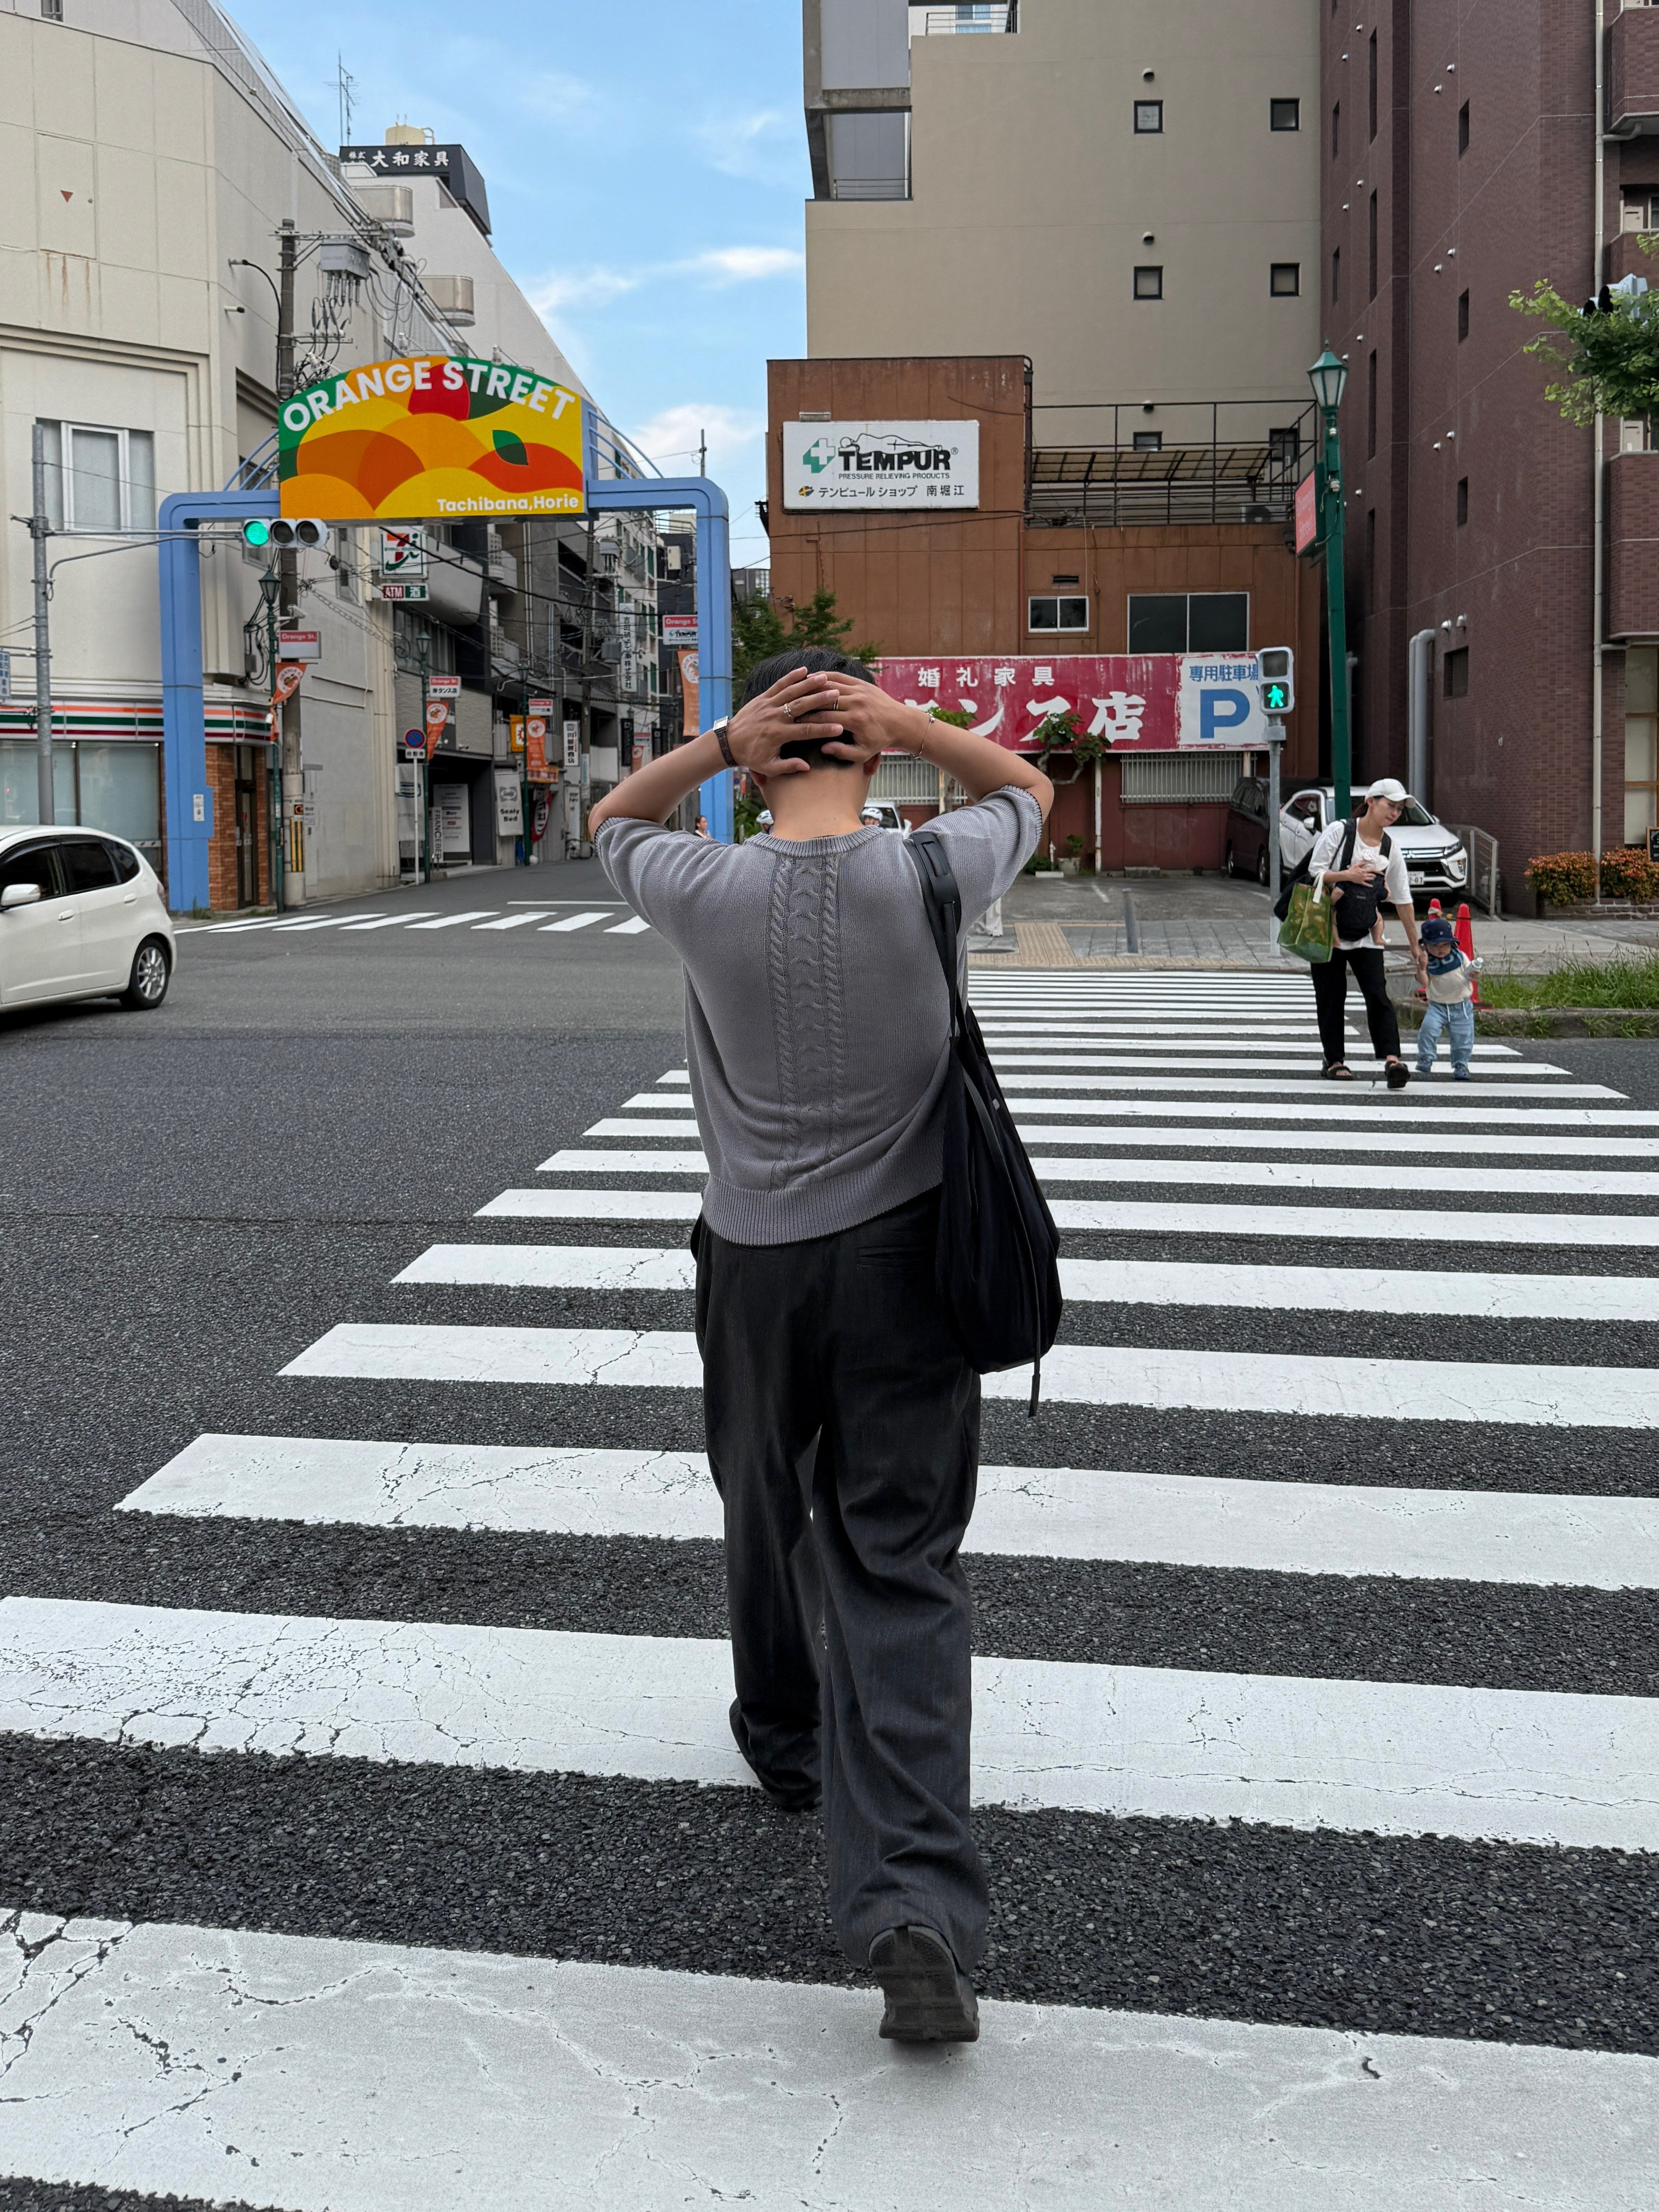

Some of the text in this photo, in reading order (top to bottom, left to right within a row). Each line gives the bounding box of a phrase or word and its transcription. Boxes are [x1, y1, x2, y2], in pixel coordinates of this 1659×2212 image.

[370, 150, 449, 167] 大和家具
[284, 361, 575, 431] ORANGE STREET
[927, 485, 964, 496] 南堀江
[437, 494, 579, 512] Tachibana,Horie
[386, 586, 403, 597] ATM
[410, 586, 421, 598] 酒
[918, 666, 1055, 687] 婚礼家具
[1189, 664, 1258, 682] 専用駐車場
[1200, 689, 1250, 739] P
